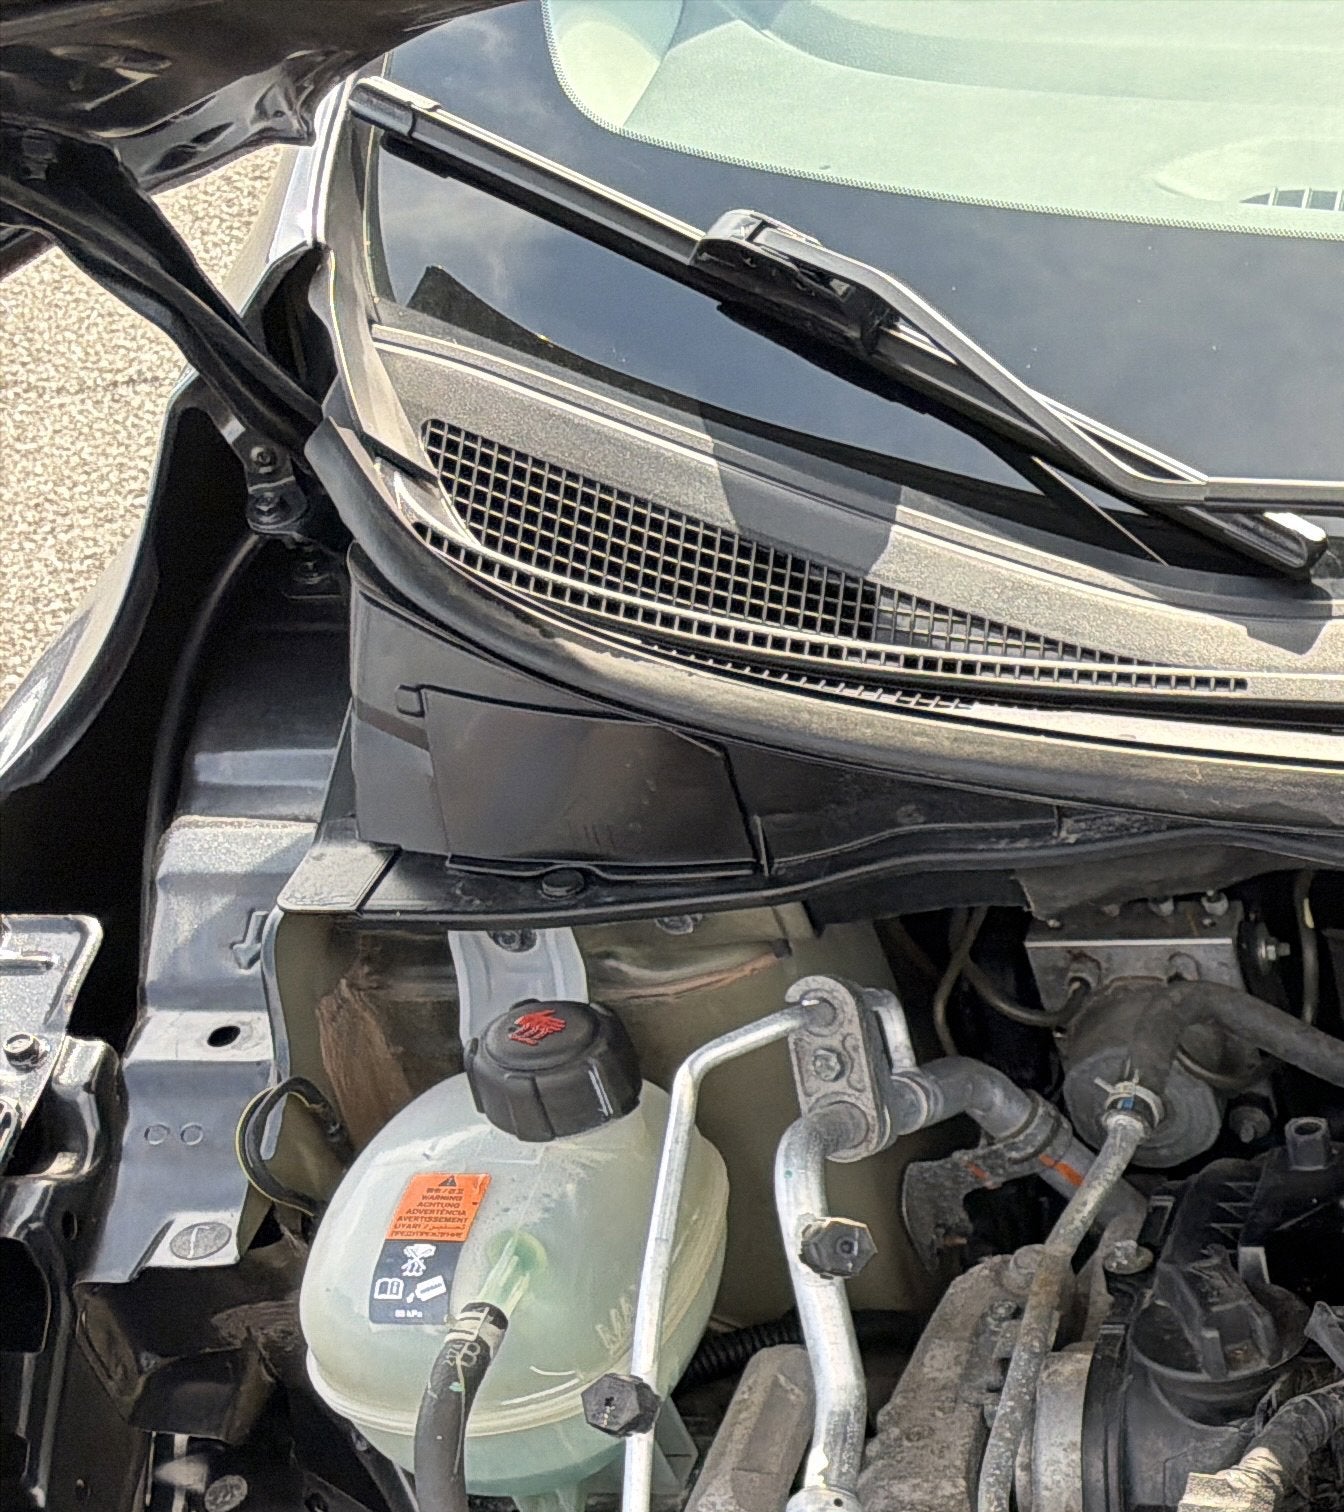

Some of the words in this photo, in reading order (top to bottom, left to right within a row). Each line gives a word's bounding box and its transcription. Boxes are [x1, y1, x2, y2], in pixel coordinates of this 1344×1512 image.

[421, 1194, 463, 1202] WARNING
[416, 1201, 461, 1209] ACHTUNG
[397, 1215, 468, 1224] AVERTISSEMENT
